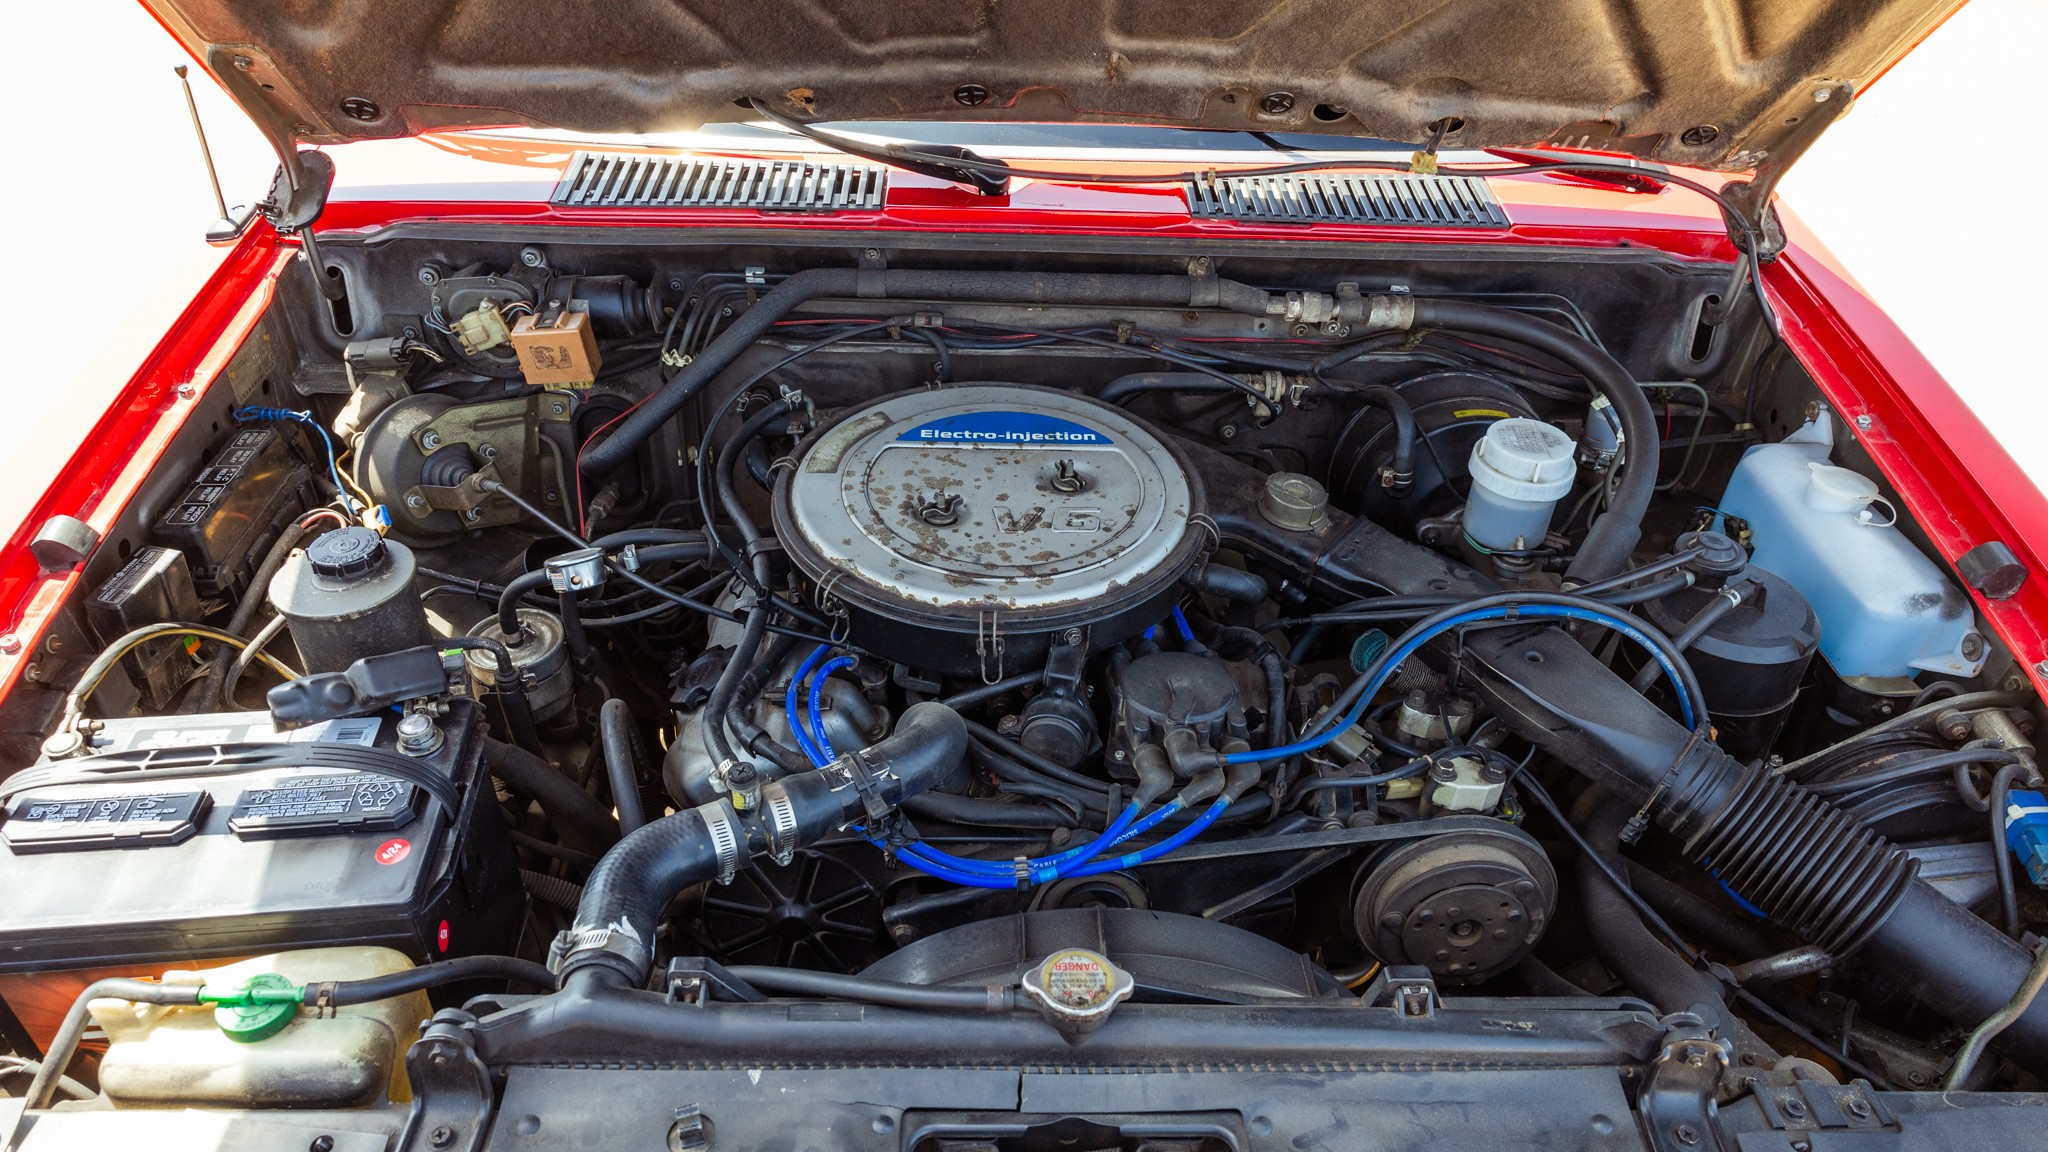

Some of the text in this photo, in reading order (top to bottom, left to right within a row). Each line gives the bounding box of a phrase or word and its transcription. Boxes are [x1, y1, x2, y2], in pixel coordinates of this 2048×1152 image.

[237, 432, 251, 445] RELAY
[920, 429, 1097, 442] Electro-injection
[230, 450, 244, 463] RELAY
[214, 468, 229, 482] RELAY
[198, 486, 213, 501] RELAY
[181, 505, 197, 520] RELAY
[188, 505, 206, 522] CHECK
[992, 505, 1102, 533] V6
[1625, 628, 1643, 641] CABLE
[1644, 640, 1660, 653] PLUG
[381, 842, 403, 860] 4/24
[1055, 962, 1099, 971] DANGER
